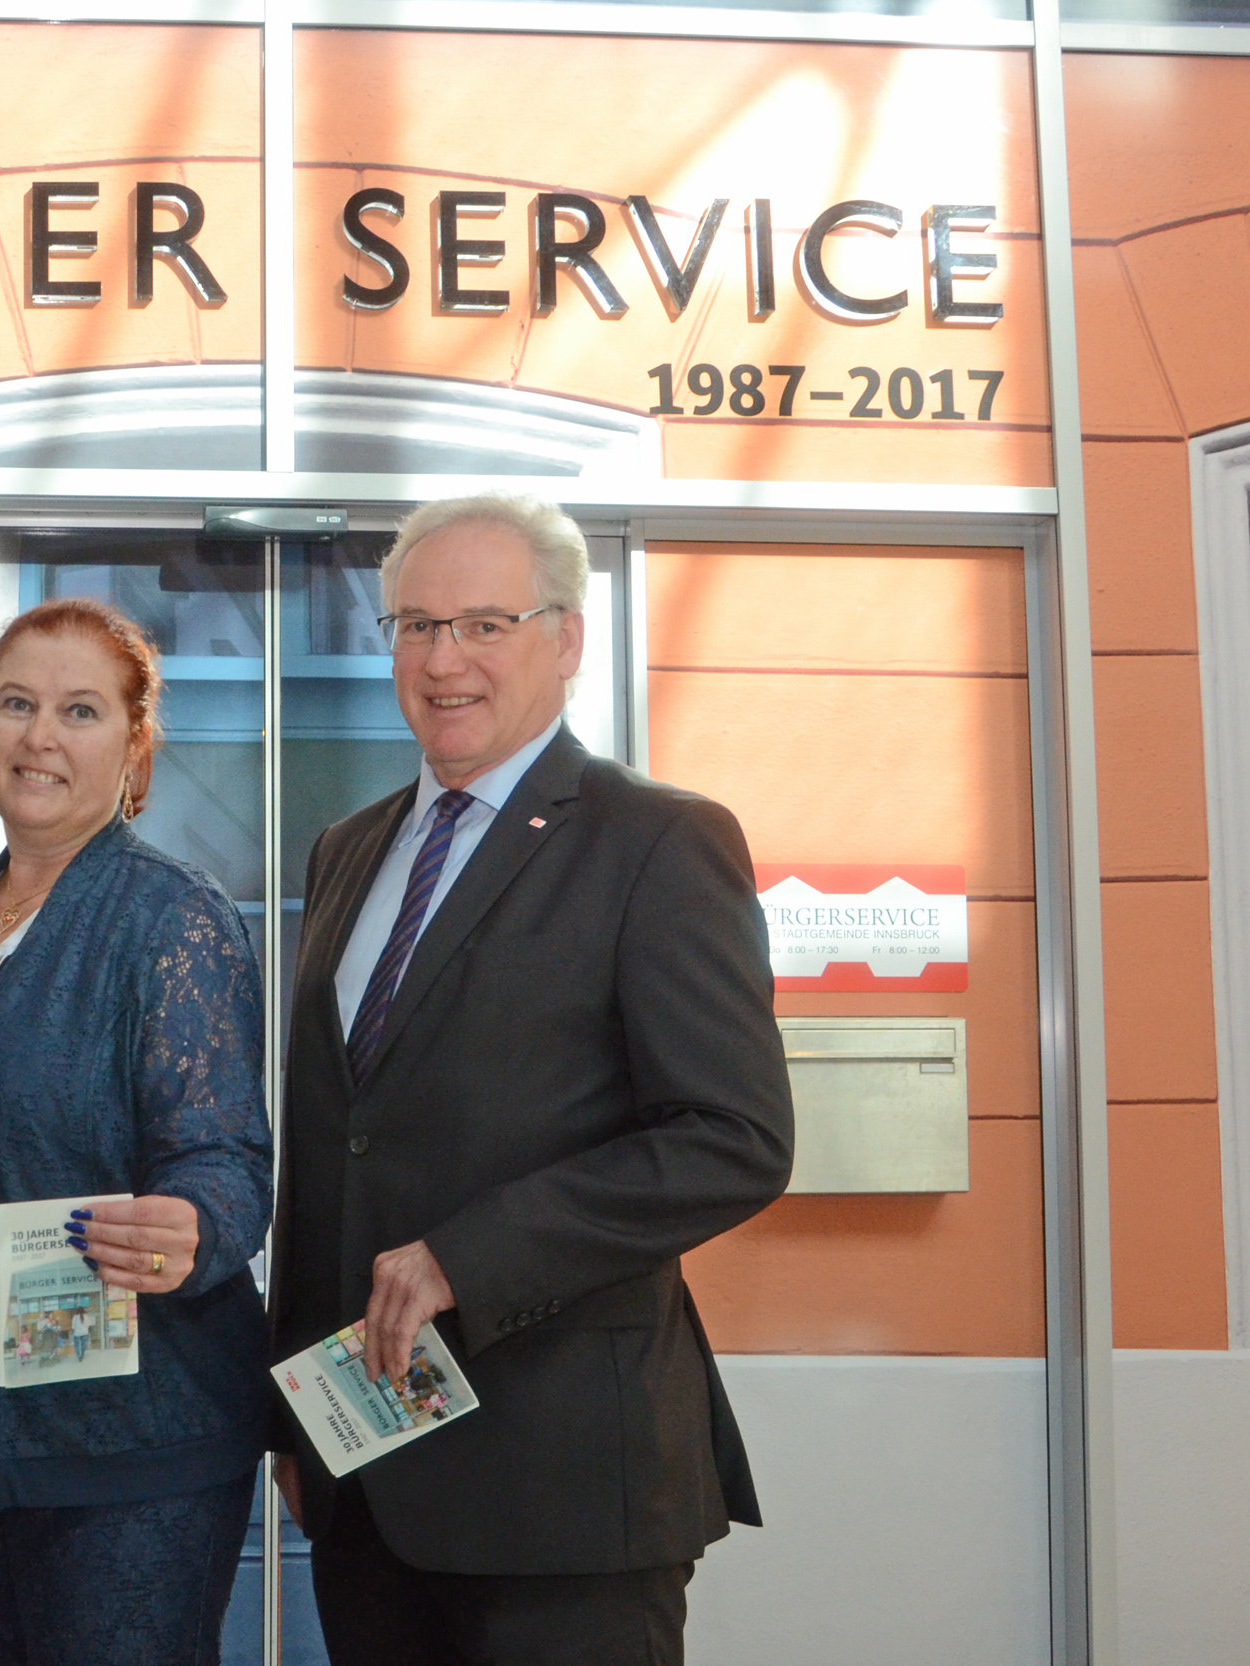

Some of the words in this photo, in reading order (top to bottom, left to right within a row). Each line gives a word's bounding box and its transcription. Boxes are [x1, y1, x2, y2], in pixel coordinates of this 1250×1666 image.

[341, 187, 1004, 324] SERVICE
[763, 904, 940, 926] ÜRGERSERVICE
[773, 929, 870, 939] STADTGEMEINDE
[873, 929, 940, 939] INNSBRUCK
[787, 946, 806, 954] 8:00
[816, 946, 839, 954] 17:30
[872, 946, 881, 954] Fr
[889, 946, 907, 954] 8:00
[917, 946, 940, 954] 12:00
[10, 1231, 24, 1241] 30
[26, 1227, 60, 1242] JAHRE
[11, 1238, 71, 1254] BÜRGERSE
[19, 1278, 57, 1290] BÜRGER
[347, 1364, 370, 1396] SERVICE
[315, 1374, 364, 1449] BÜRGERSERVICE
[367, 1397, 390, 1430] BÜRGER
[326, 1413, 350, 1442] JAHRE
[343, 1442, 355, 1454] 30
